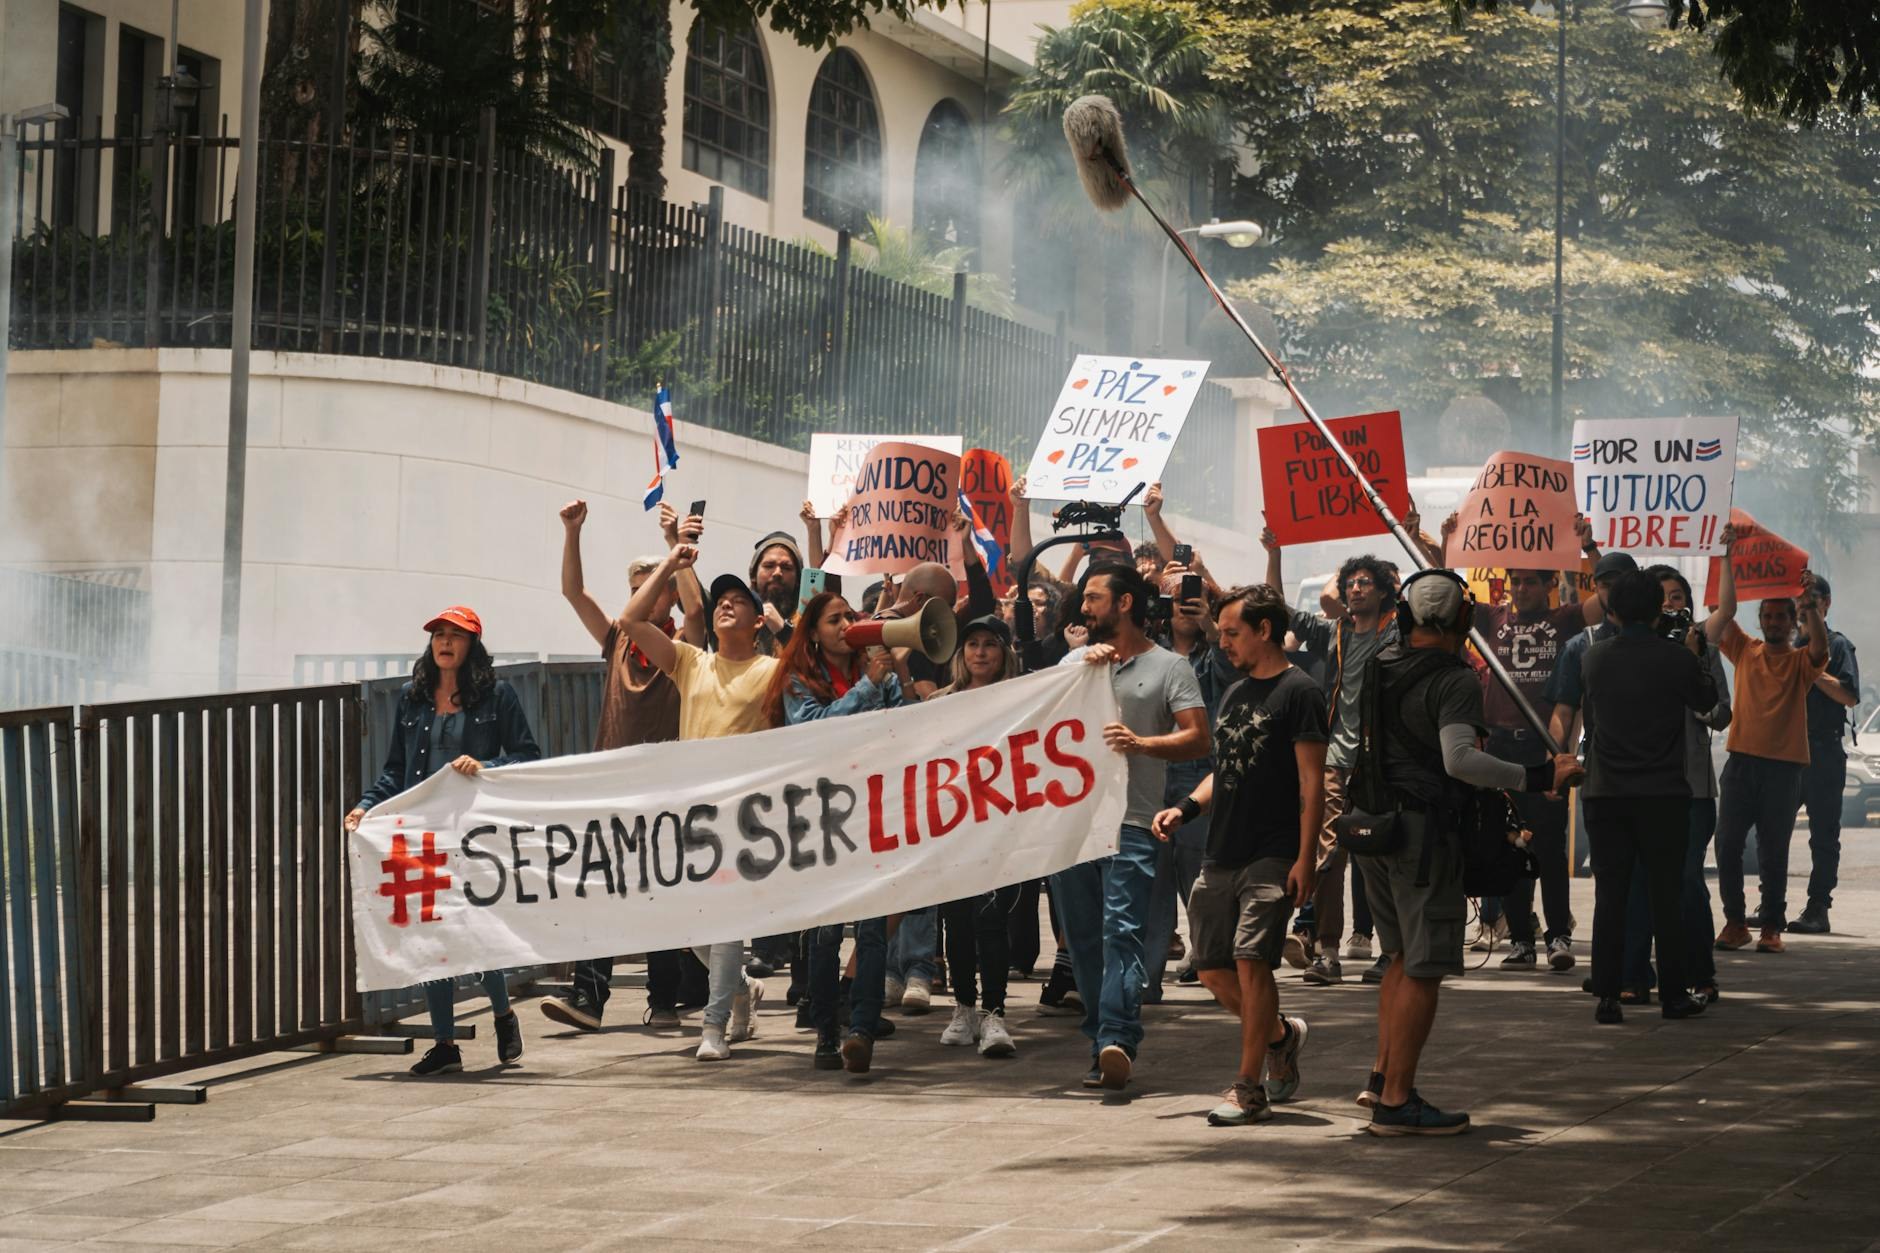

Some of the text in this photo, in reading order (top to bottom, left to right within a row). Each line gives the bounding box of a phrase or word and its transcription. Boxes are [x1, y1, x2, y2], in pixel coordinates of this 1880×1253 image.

[1053, 406, 1163, 443] SIEMPRE
[1342, 424, 1368, 447] UN
[1592, 437, 1693, 464] POR UN
[855, 456, 948, 500] UNIDOS
[1585, 474, 1706, 513] FUTURO
[851, 501, 872, 529] POR
[877, 500, 949, 532] NUESTROS
[1480, 497, 1540, 518] A LA
[1734, 552, 1788, 580] AMÁS
[377, 719, 1095, 927] #SEPAMOS SER LIBRES
